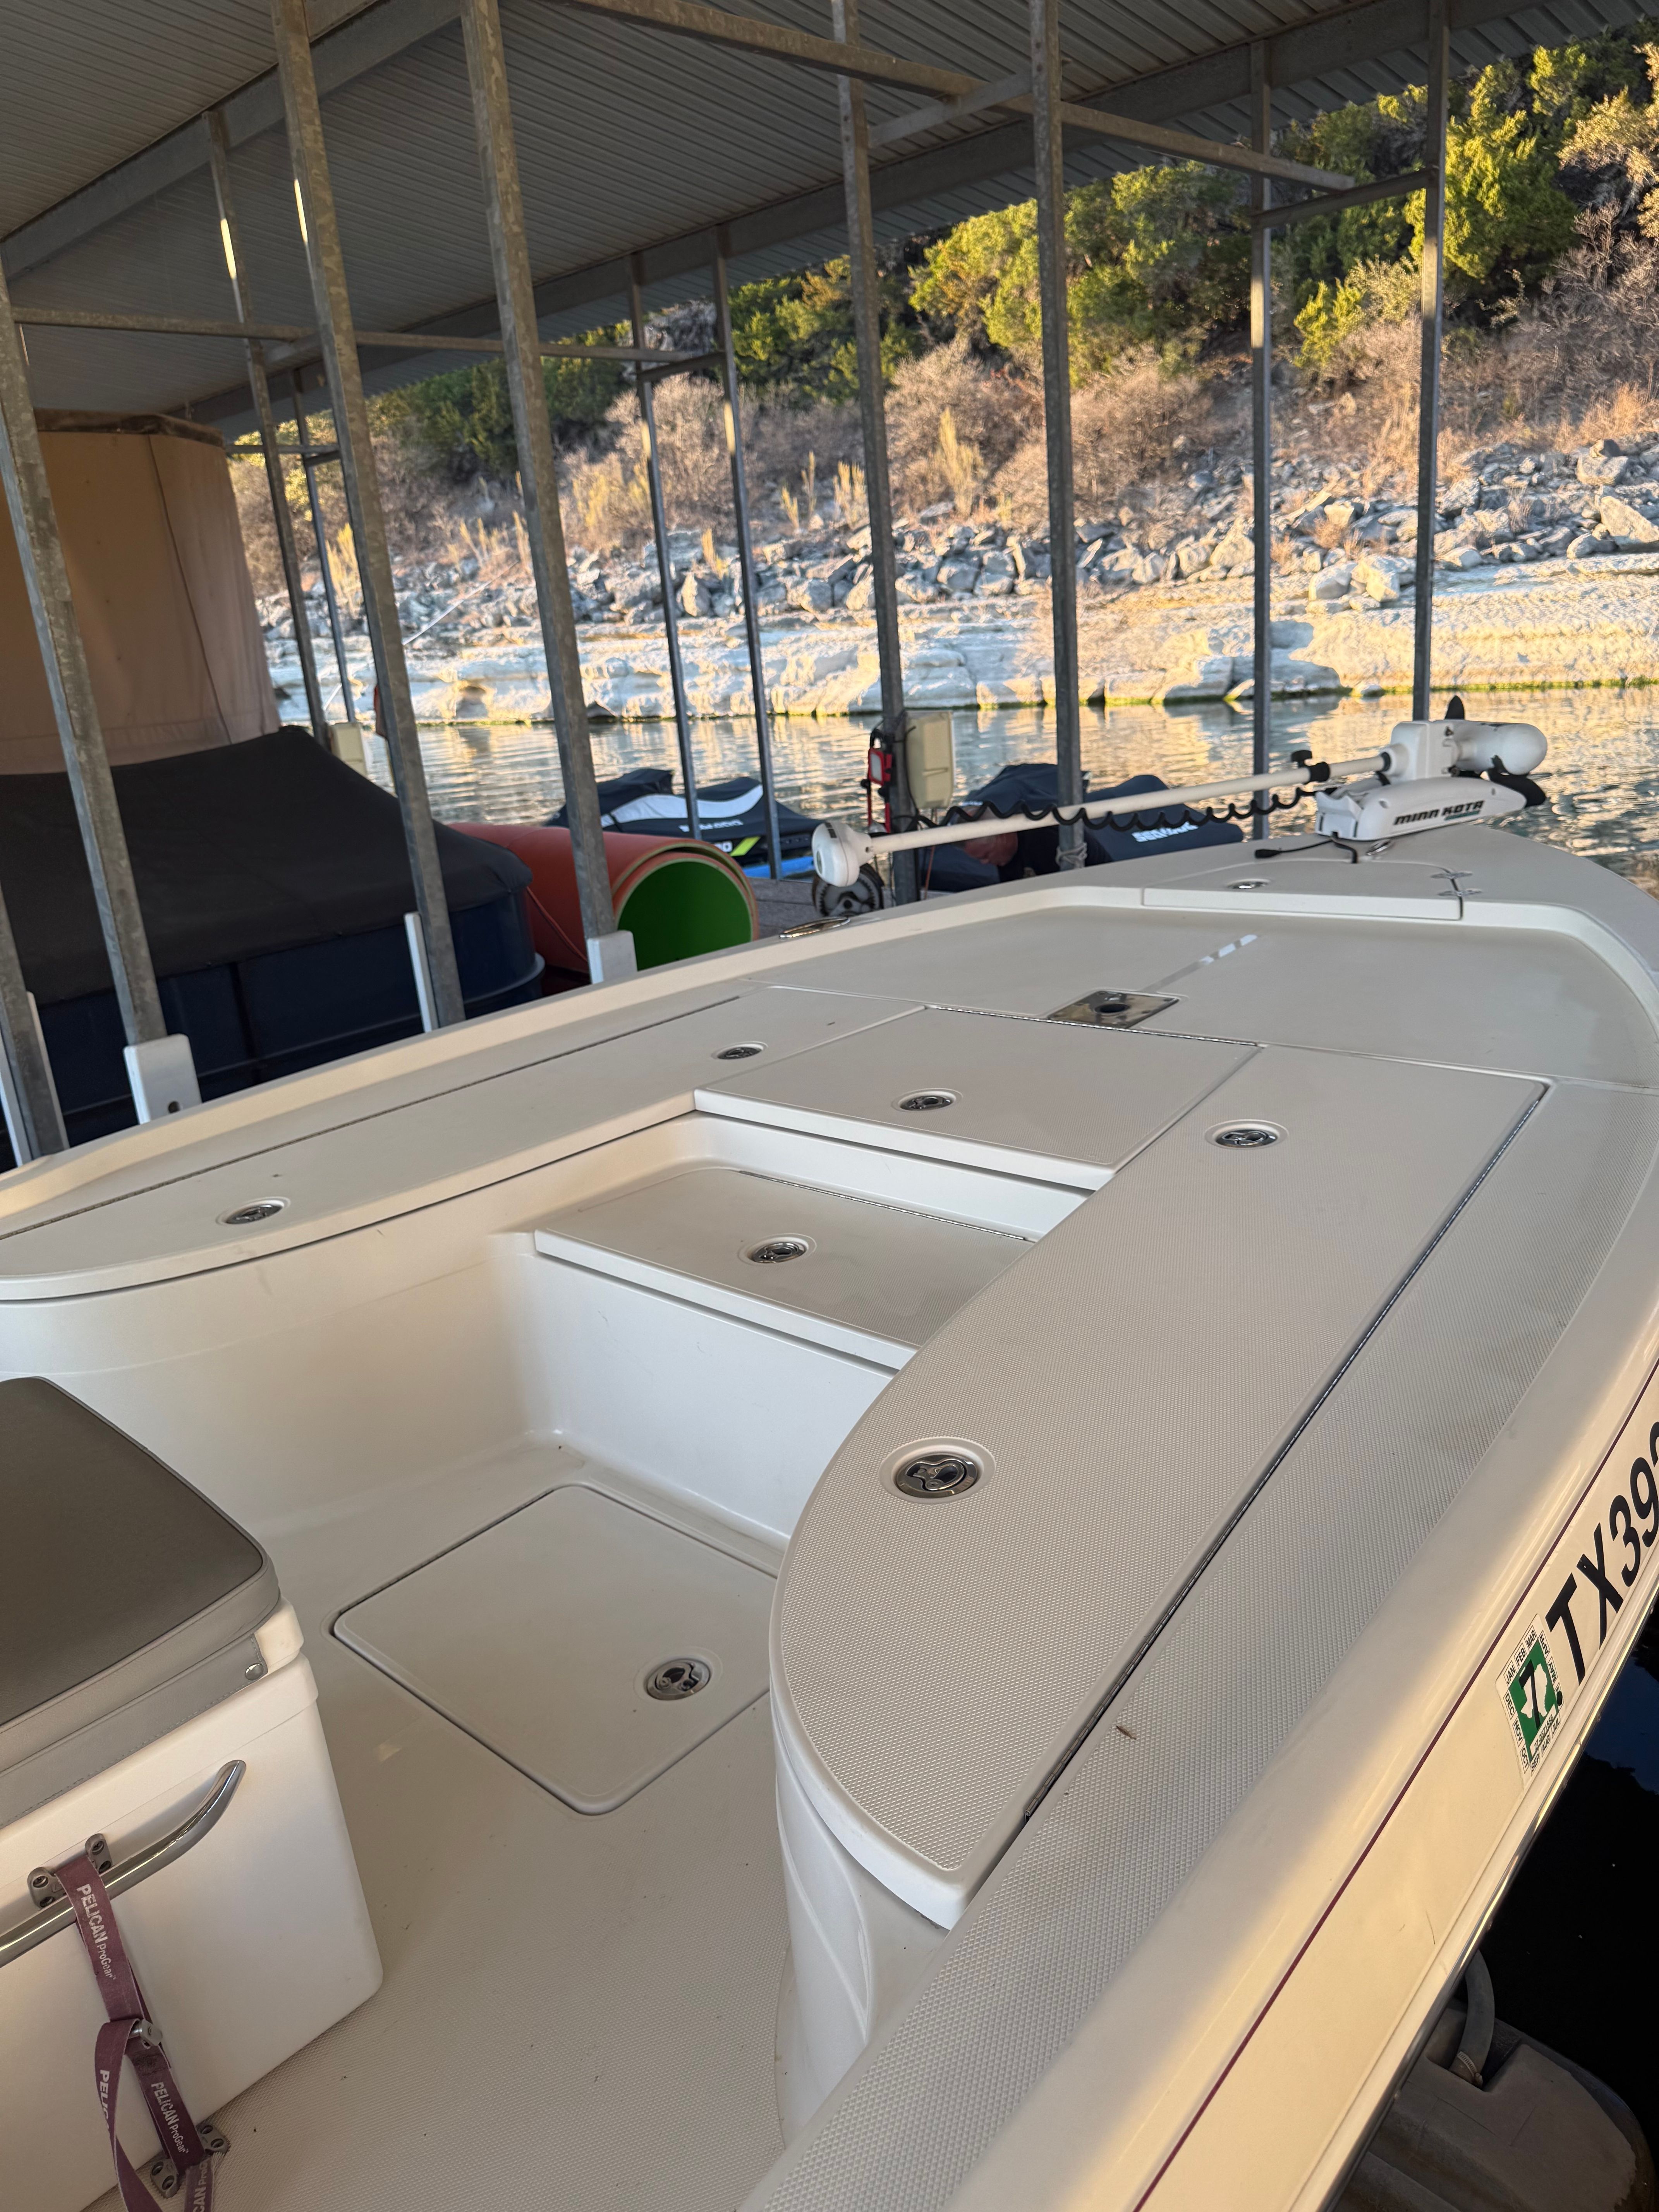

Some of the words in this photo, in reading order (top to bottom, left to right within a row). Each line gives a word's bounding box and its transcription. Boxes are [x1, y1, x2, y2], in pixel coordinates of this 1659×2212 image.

[1441, 800, 1485, 816] KOTA
[1506, 1664, 1516, 1685] JAN
[1516, 1647, 1526, 1666] FEB
[1526, 1630, 1537, 1649] MAR
[1539, 1633, 1549, 1655] APR
[1518, 1659, 1541, 1730] 7
[1548, 1662, 1558, 1684] MAY
[1505, 1692, 1515, 1716] DEC
[1514, 1719, 1523, 1742] NOV
[1531, 1753, 1540, 1772] SEP
[1542, 1735, 1551, 1752] AUG
[1551, 1718, 1560, 1735] JUL
[77, 1883, 108, 1944] PELICAN
[151, 2081, 180, 2126] PELICAN
